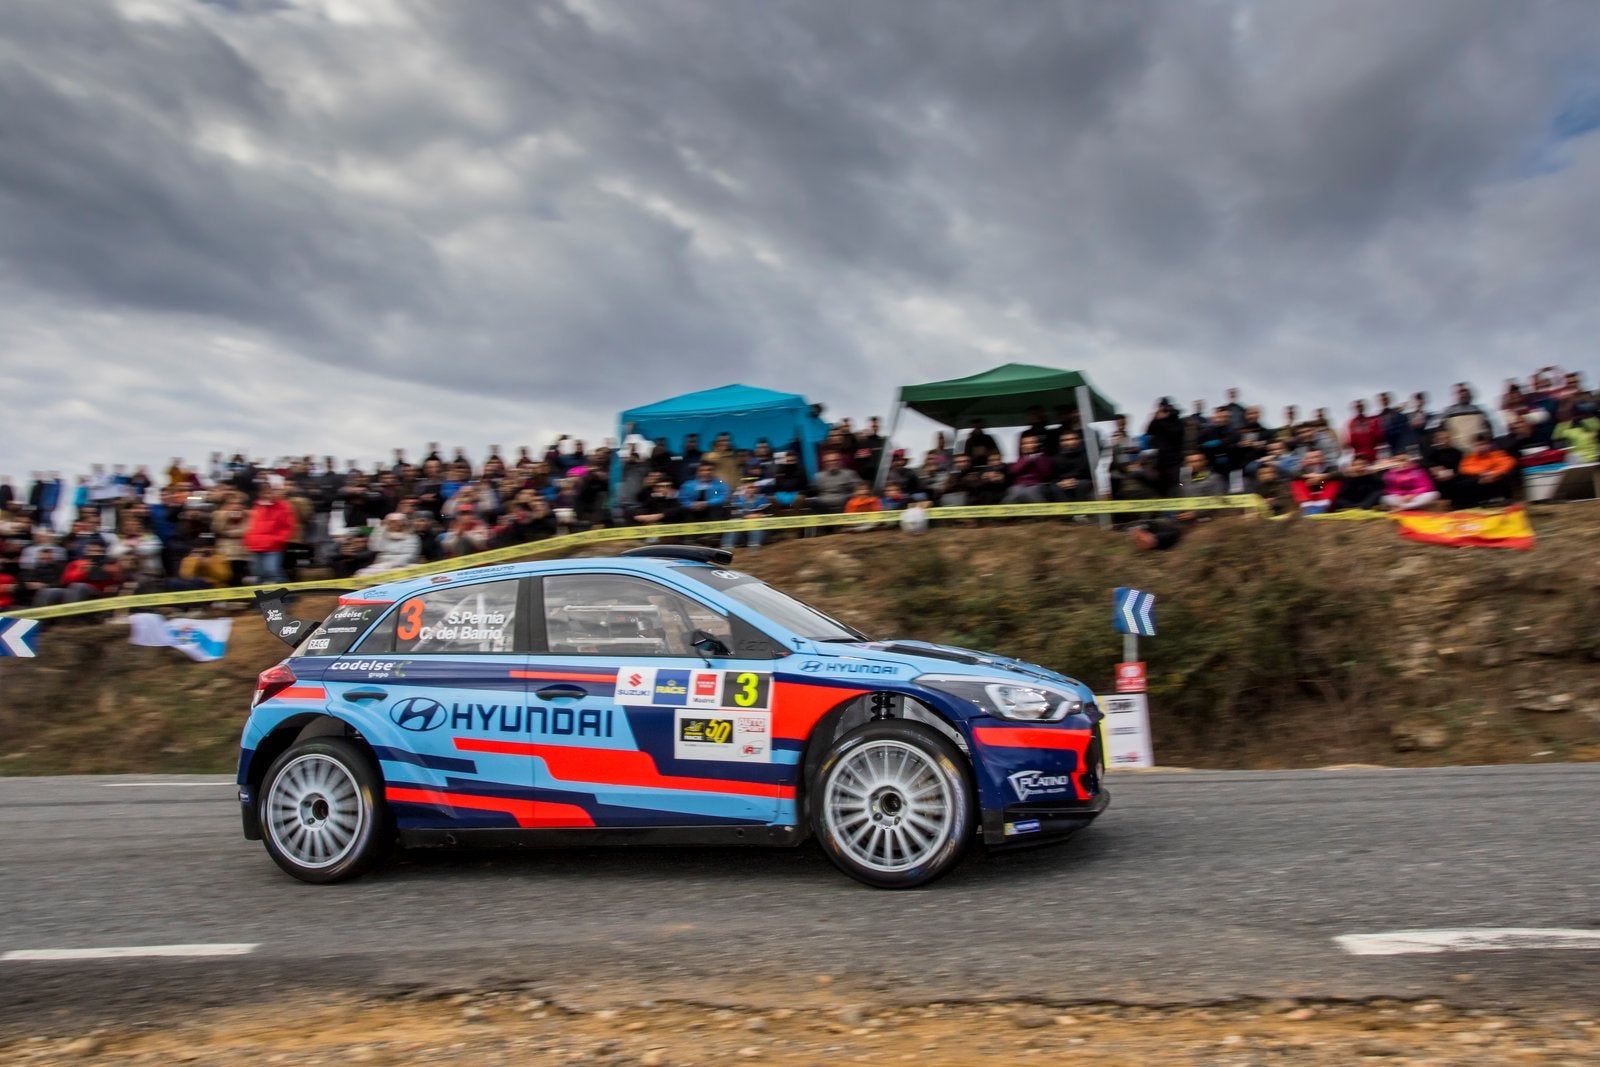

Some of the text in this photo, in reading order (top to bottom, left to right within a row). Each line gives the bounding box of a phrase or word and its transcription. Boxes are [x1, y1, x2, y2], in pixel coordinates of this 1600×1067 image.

[397, 599, 425, 640] 3
[419, 626, 503, 640] C. del Barrio
[309, 639, 329, 649] RACC
[330, 660, 394, 671] codelse
[826, 662, 898, 675] HYUNDAI
[617, 689, 650, 697] SUZUKI
[655, 685, 687, 695] RACE
[734, 672, 759, 707] 3
[451, 703, 613, 737] HYUNDAI
[705, 719, 732, 744] 50
